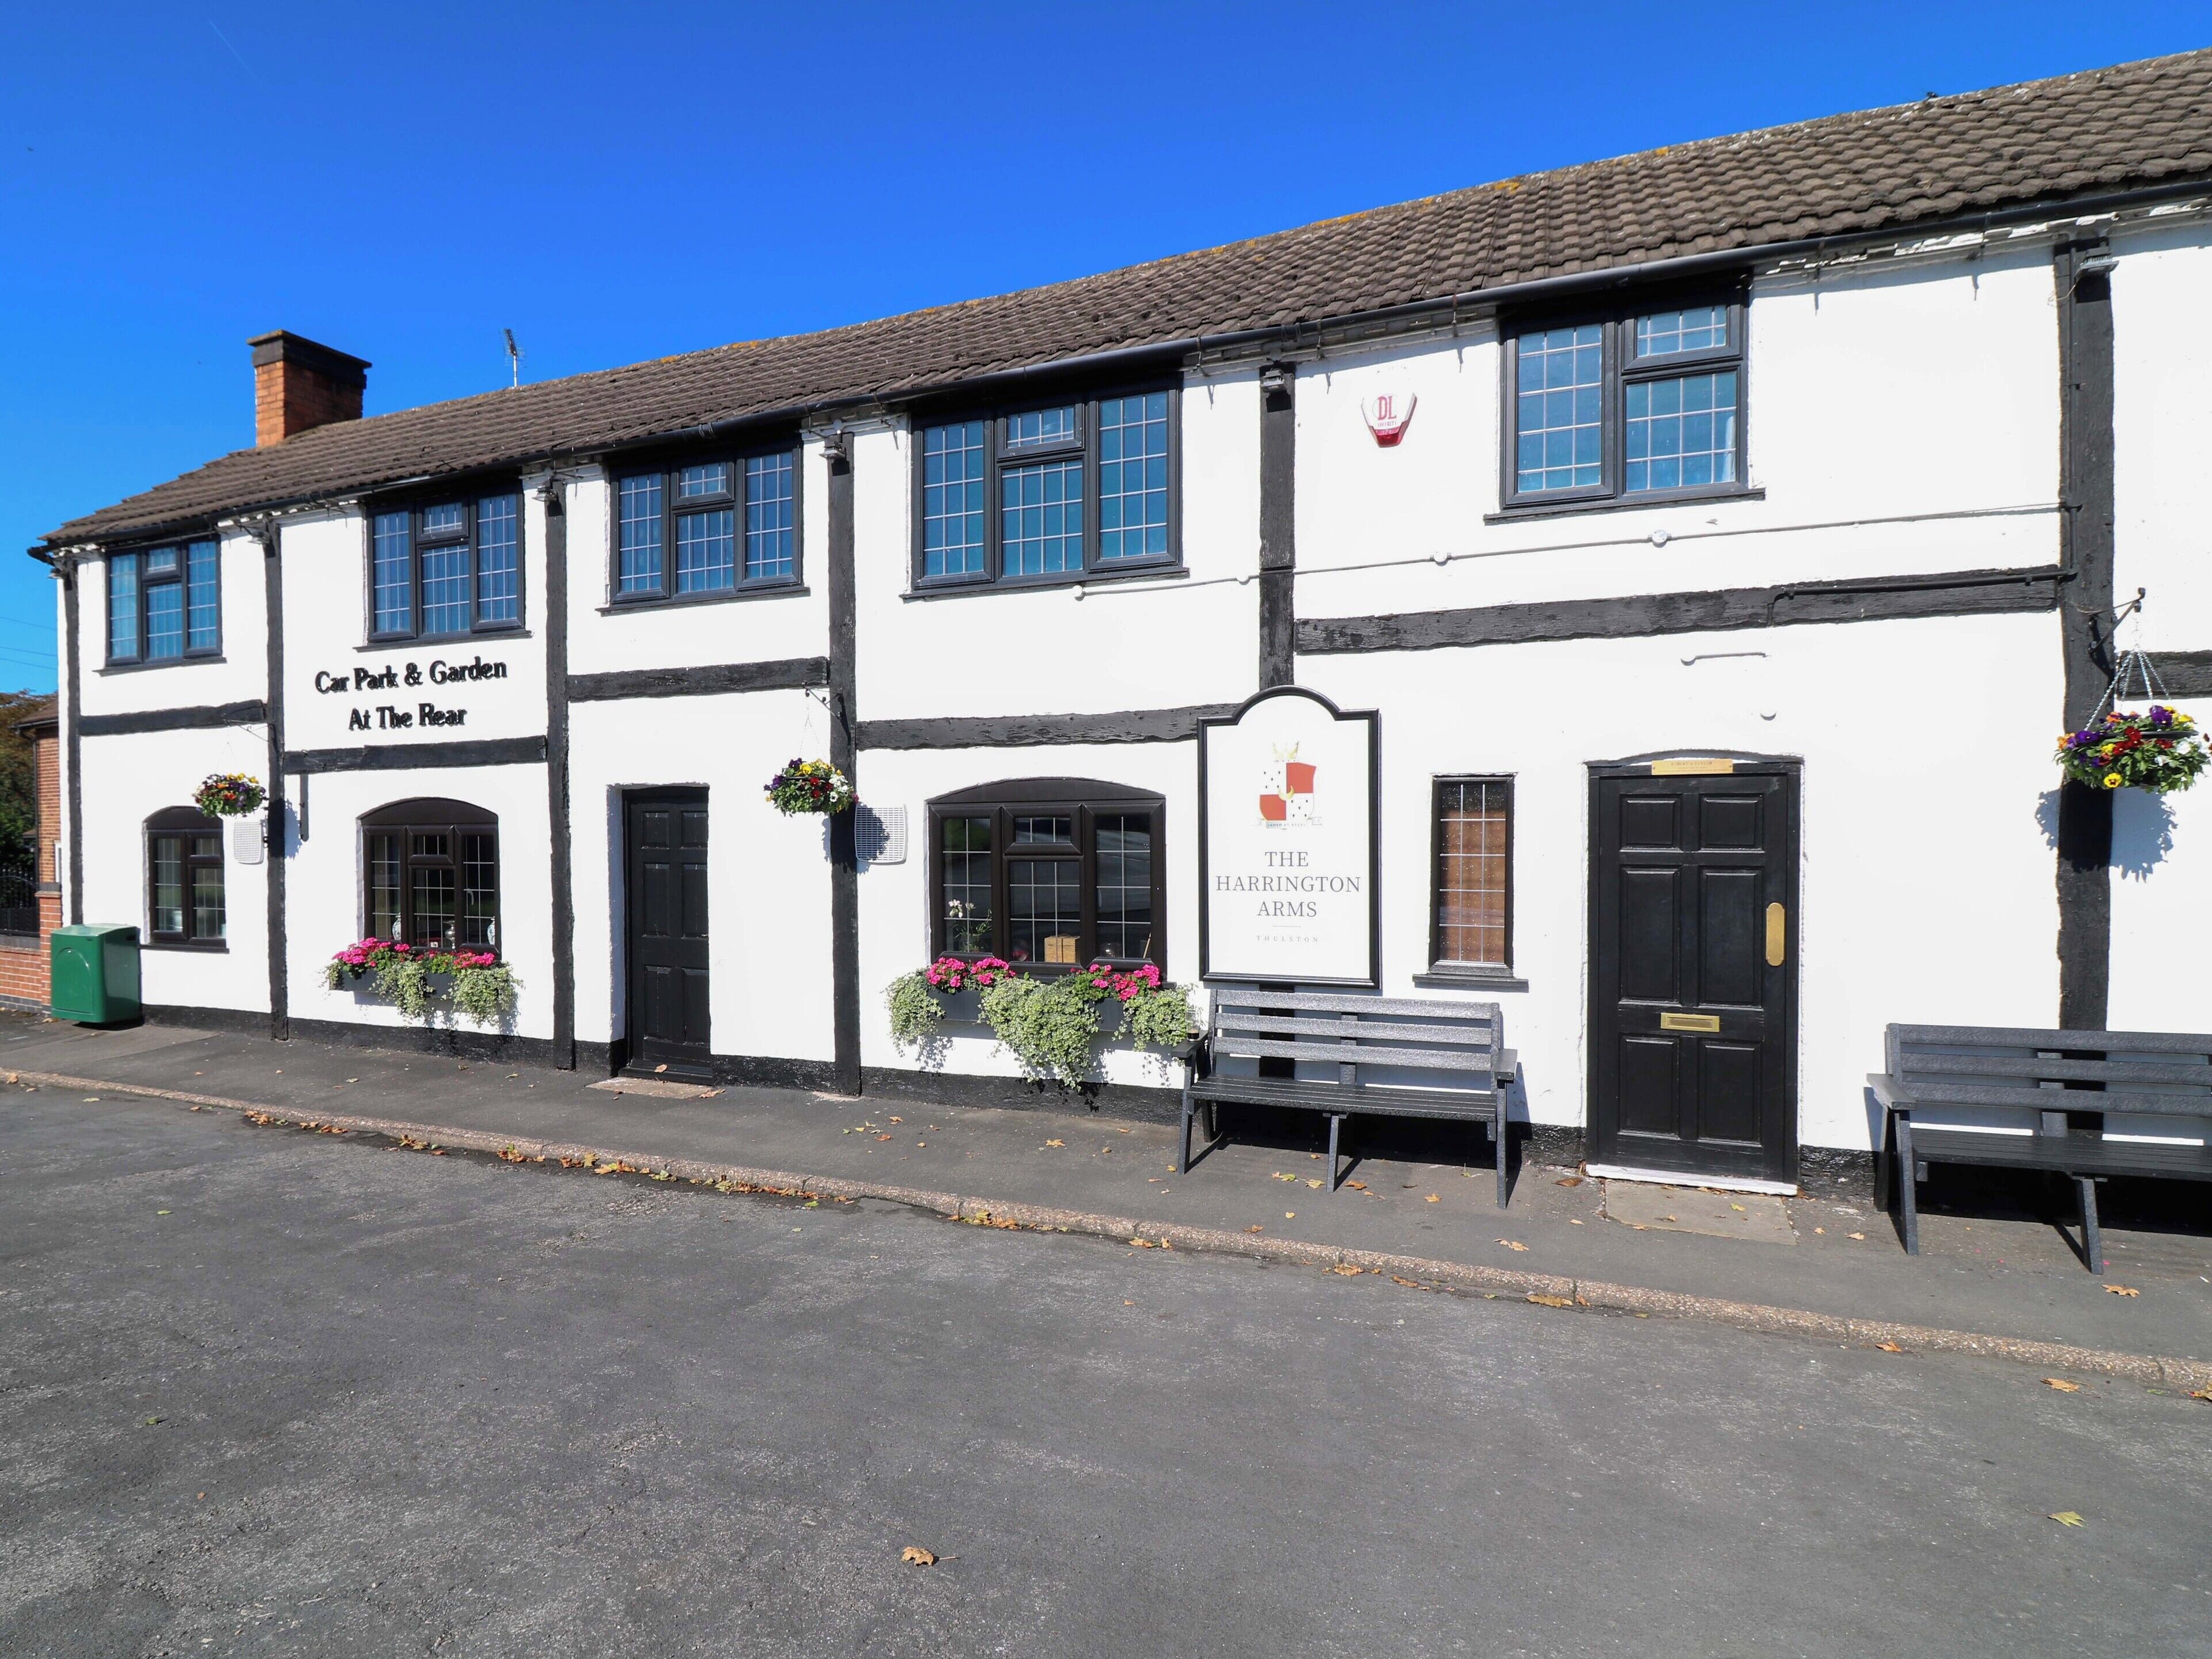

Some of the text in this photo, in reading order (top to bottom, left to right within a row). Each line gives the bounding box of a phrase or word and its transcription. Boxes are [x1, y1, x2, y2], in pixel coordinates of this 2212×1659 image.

[1377, 395, 1397, 421] DL
[315, 656, 507, 694] Car Park & Garden
[349, 703, 468, 731] At The Rear
[1264, 851, 1309, 867] THE
[1216, 876, 1361, 893] HARRINGTON
[1257, 901, 1317, 918] ARMS
[1257, 935, 1319, 943] THULSTON
